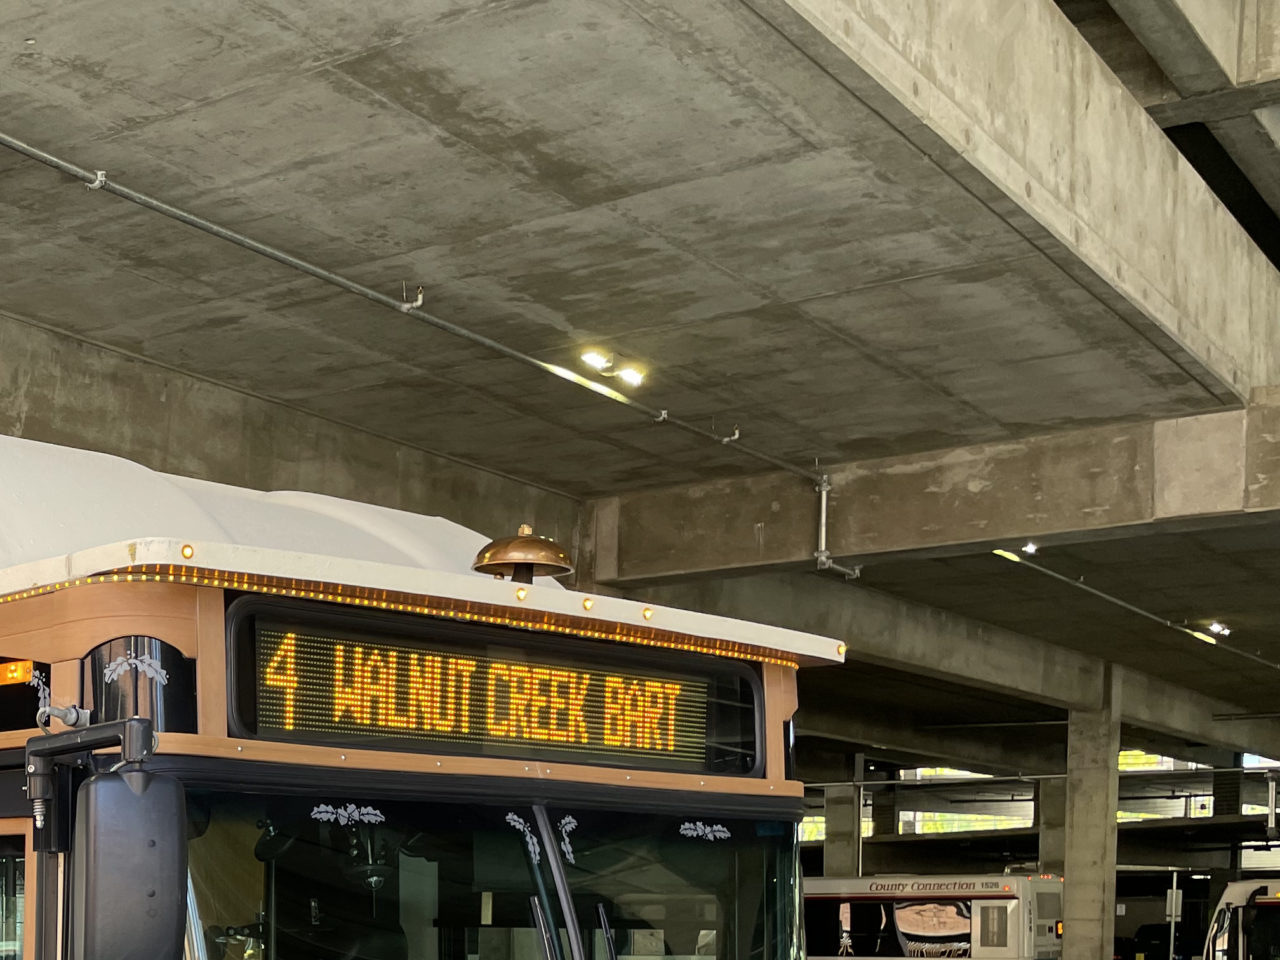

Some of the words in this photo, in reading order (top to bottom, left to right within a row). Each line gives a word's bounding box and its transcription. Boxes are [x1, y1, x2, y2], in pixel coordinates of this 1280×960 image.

[265, 632, 298, 730] 4
[334, 644, 477, 734] WALNUT
[486, 662, 592, 744] CREEK
[603, 676, 682, 751] BART
[870, 882, 908, 892] County
[911, 882, 976, 892] Connection
